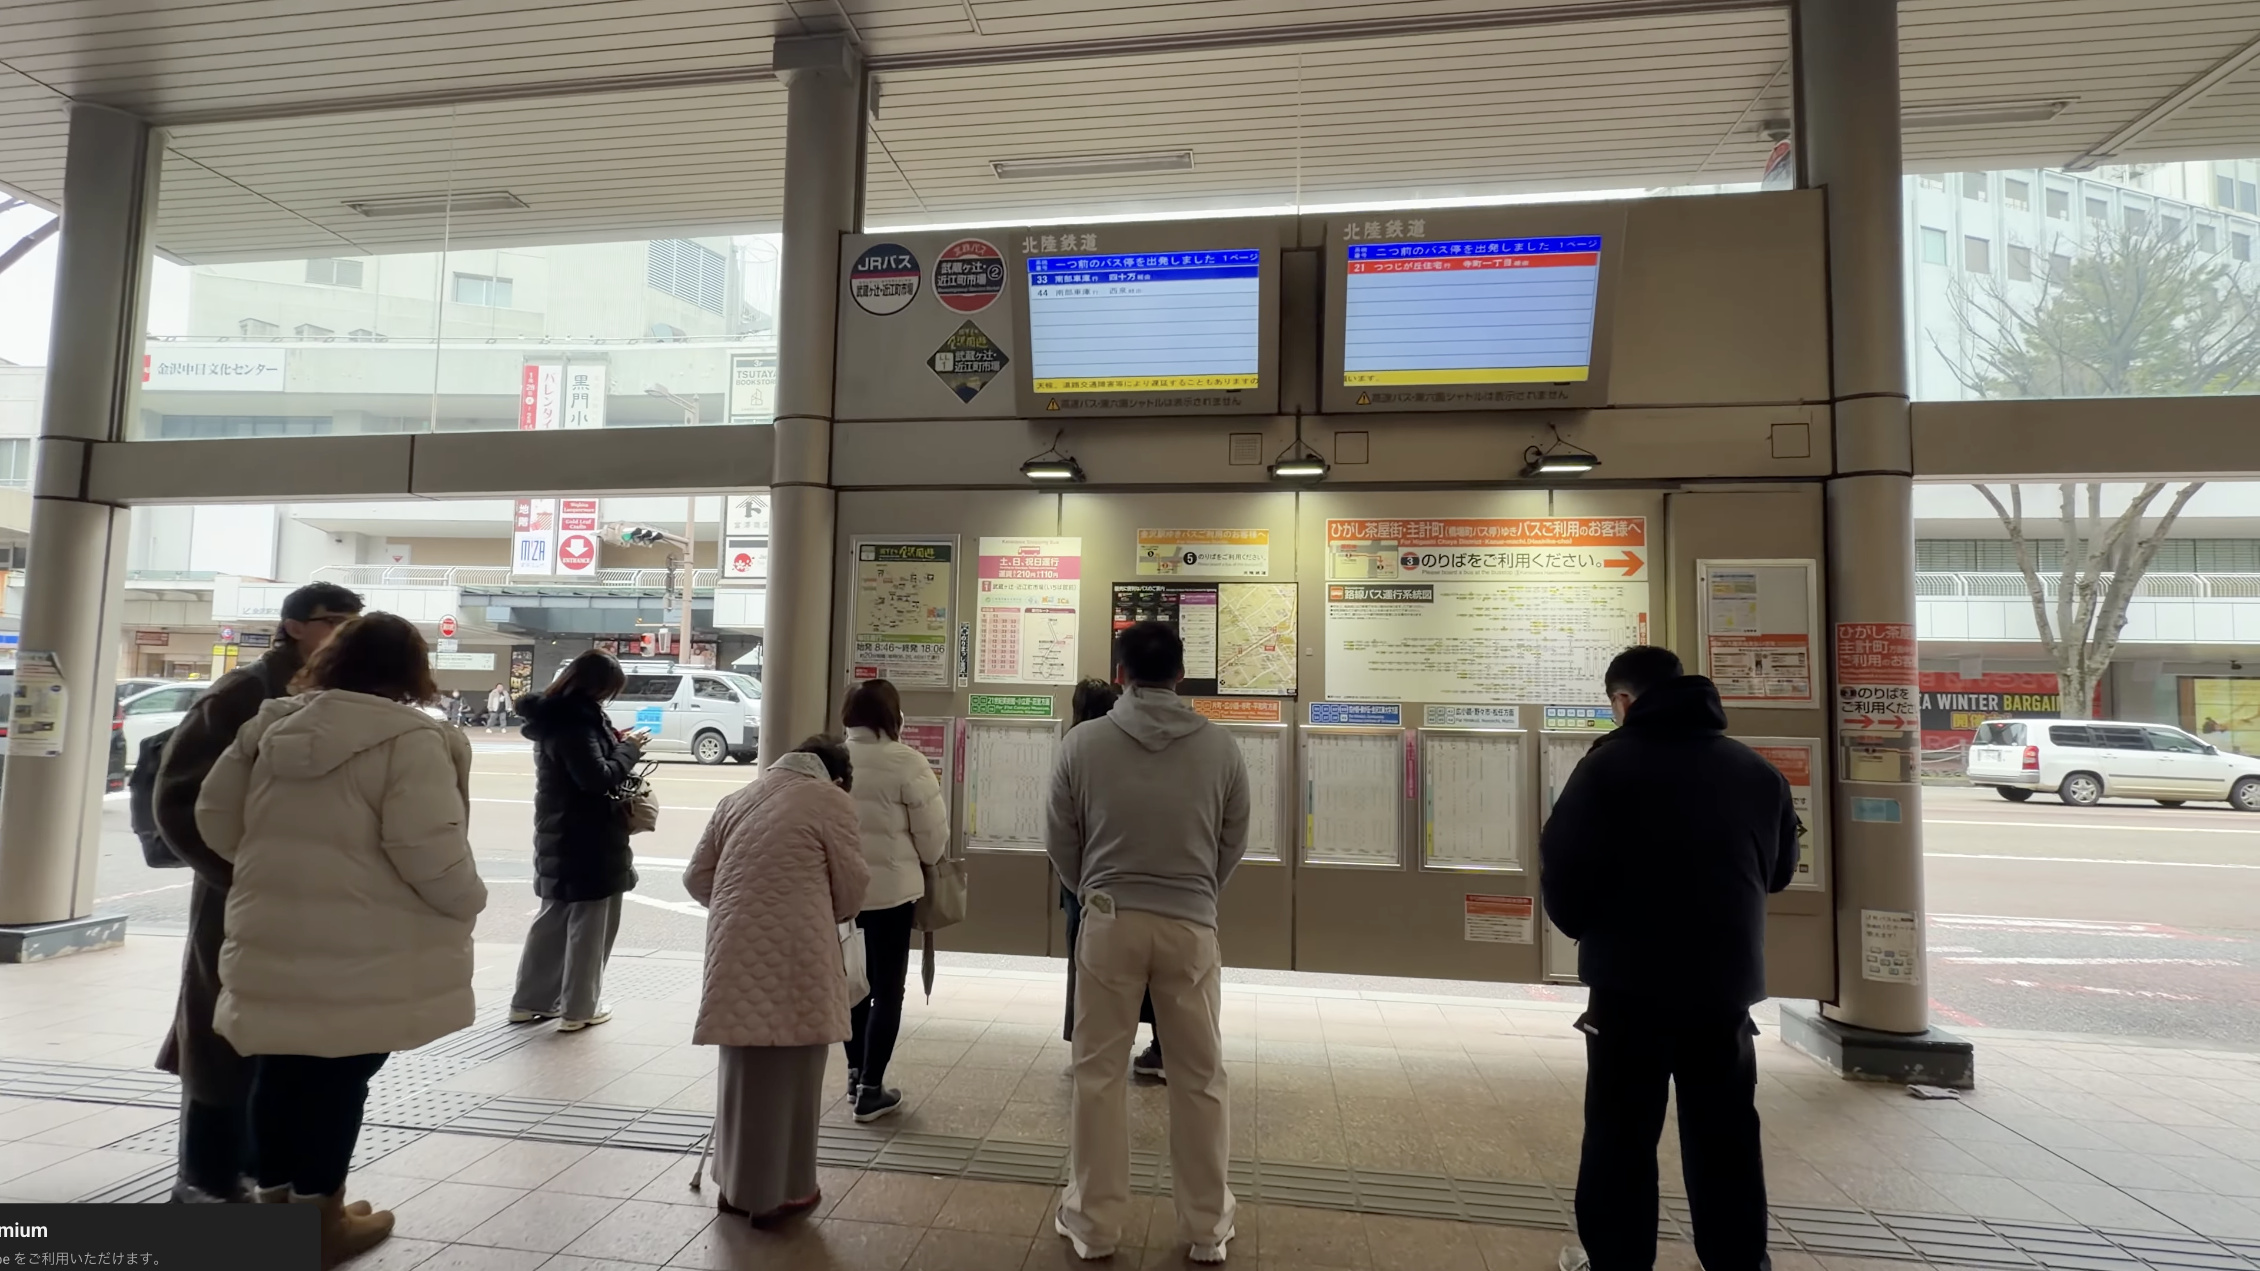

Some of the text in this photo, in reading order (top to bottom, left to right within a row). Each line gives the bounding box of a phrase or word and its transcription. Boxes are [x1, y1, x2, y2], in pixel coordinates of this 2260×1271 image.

[1343, 219, 1426, 240] 北陸鉄道
[1022, 233, 1098, 253] 北陸鉄道
[1376, 242, 1549, 257] 二つ前のバス停を出発しました
[857, 254, 912, 271] JRバス
[1055, 254, 1215, 269] 一つ前のバス停を出発しました
[1353, 263, 1366, 273] 21
[937, 274, 987, 287] 近江町市場
[1036, 275, 1048, 285] 33
[1037, 288, 1048, 297] 44
[157, 363, 278, 376] 金沢中日文化センター
[1421, 552, 1602, 569] のりばをご利用ください。
[1344, 589, 1432, 600] 路線バス運行系統図
[921, 644, 945, 654] 18:06
[1858, 687, 1909, 700] のりばを
[1919, 693, 1932, 710] A
[1937, 694, 1999, 711] WINTER
